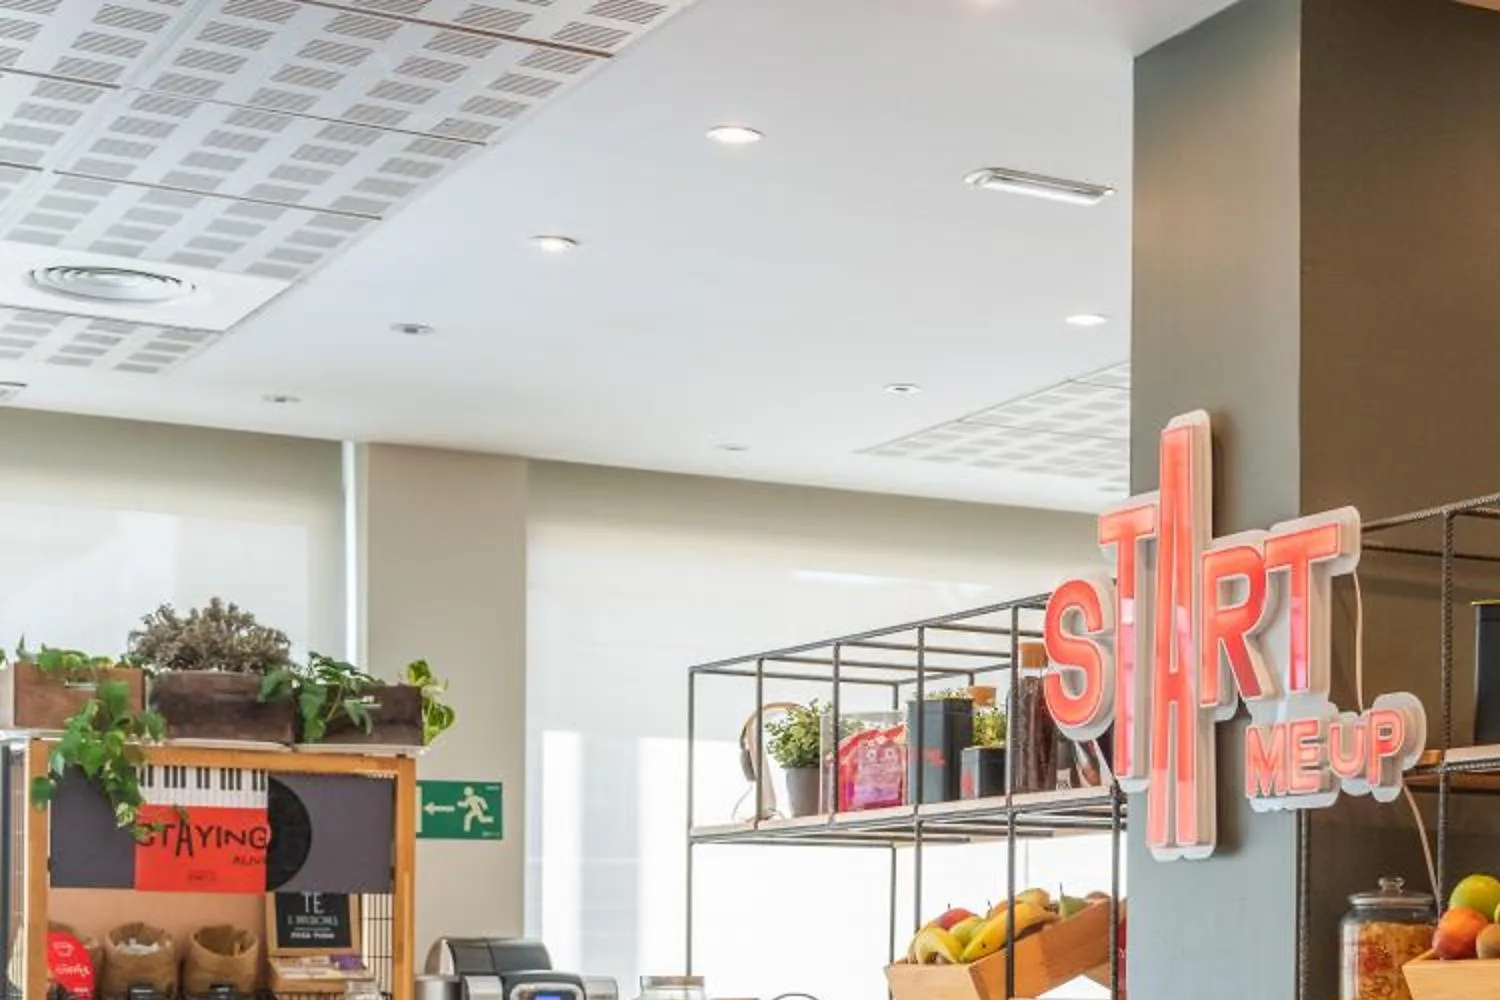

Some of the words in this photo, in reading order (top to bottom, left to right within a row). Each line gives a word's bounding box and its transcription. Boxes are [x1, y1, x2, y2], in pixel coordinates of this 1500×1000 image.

[1043, 424, 1341, 848] START
[1246, 718, 1321, 797] ME
[1329, 708, 1406, 785] UP
